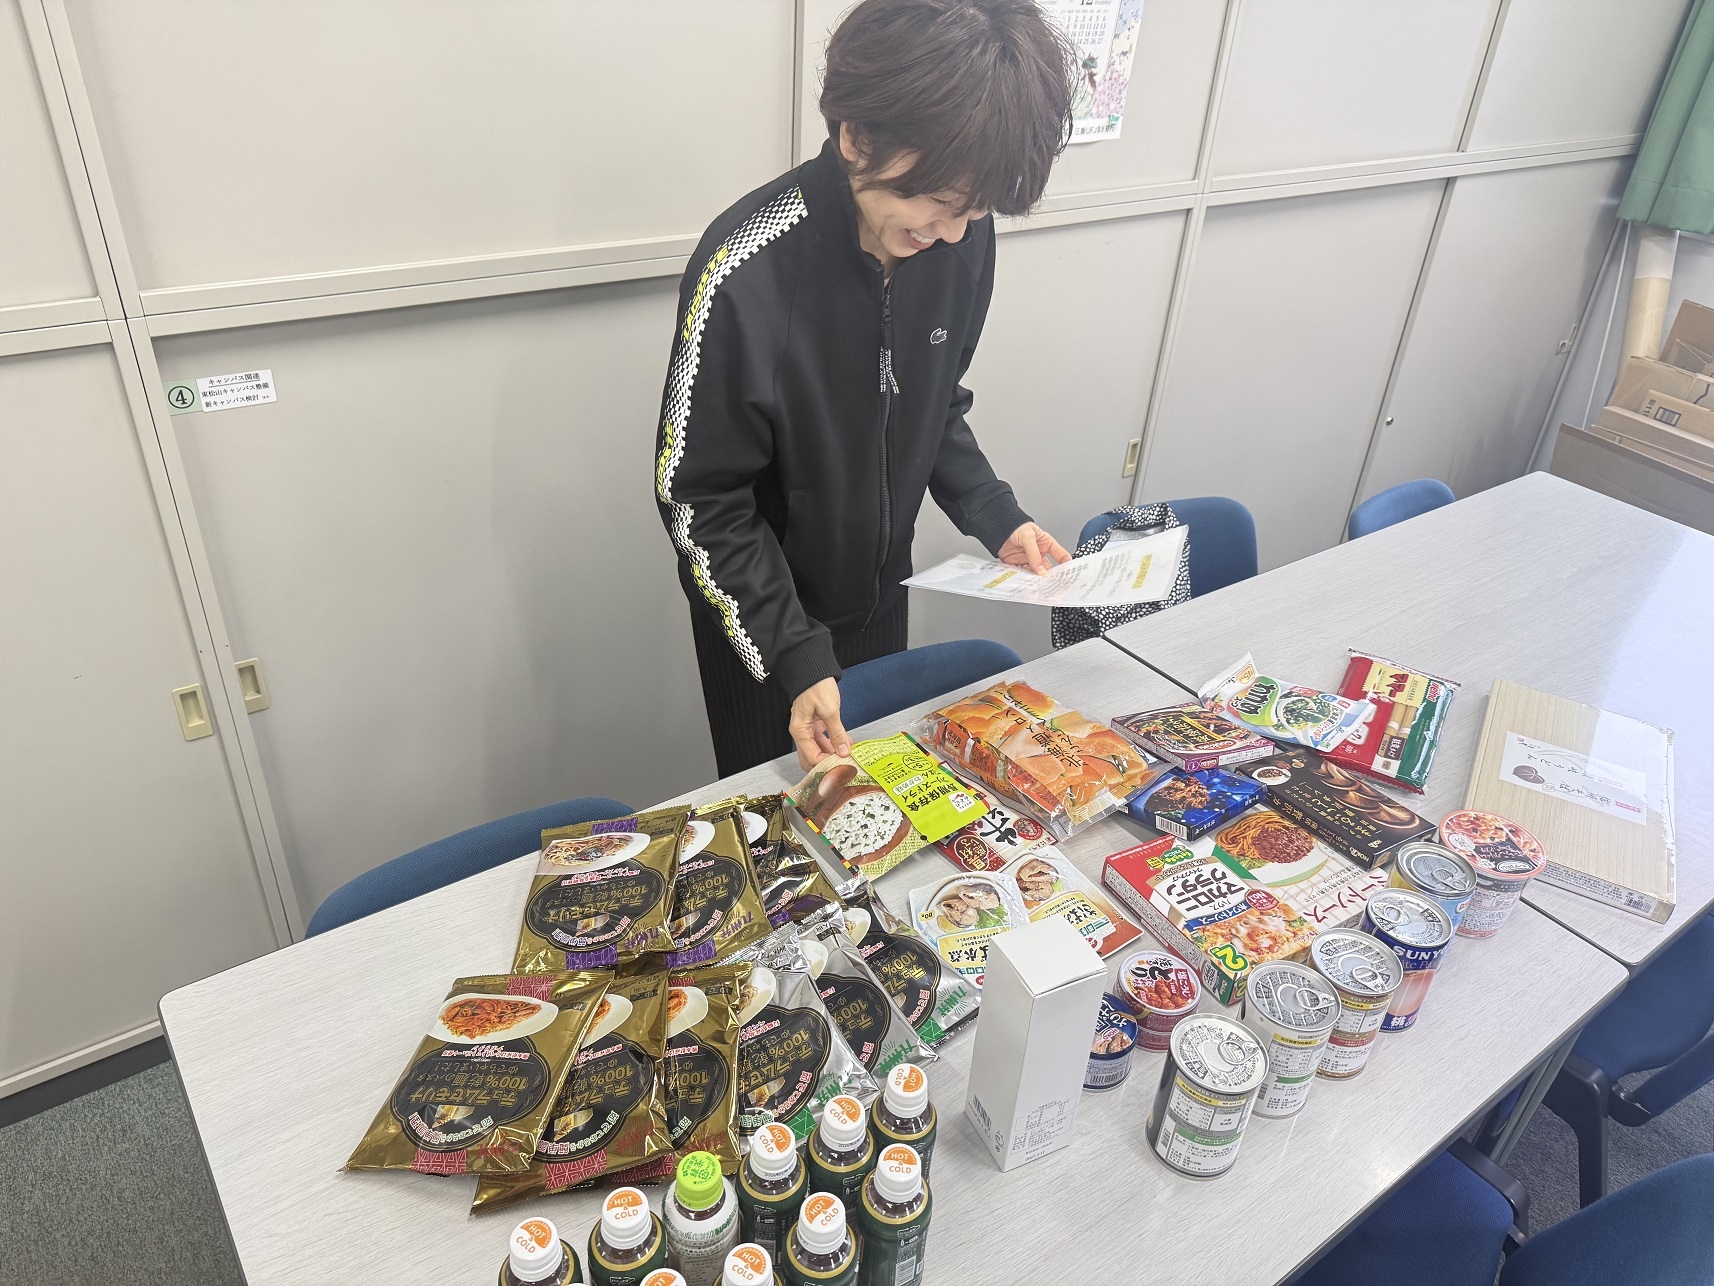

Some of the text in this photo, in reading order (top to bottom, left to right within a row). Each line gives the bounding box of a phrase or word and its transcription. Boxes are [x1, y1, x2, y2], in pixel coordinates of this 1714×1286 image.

[208, 373, 260, 386] キャンパス関連
[1237, 683, 1277, 716] わかめ
[1166, 868, 1227, 897] グラタン
[1176, 881, 1245, 911] マカロニ
[1198, 903, 1248, 926] ホワイトソース
[936, 985, 967, 1018] 九州発
[895, 1068, 904, 1086] COLD
[408, 1086, 517, 1107] デュラムセモリナ
[840, 1101, 855, 1114] HOT
[830, 1108, 847, 1125] COLD
[759, 1134, 774, 1153] COLD
[773, 1129, 785, 1144] HOT
[889, 1165, 911, 1174] COLD
[614, 1195, 633, 1206] HOT
[809, 1200, 826, 1215] HOT
[614, 1209, 639, 1220] COLD
[820, 1207, 839, 1226] COLD
[528, 1224, 546, 1239] HOT
[516, 1236, 535, 1253] COLD
[741, 1251, 760, 1266] HOT
[731, 1264, 754, 1281] COLD
